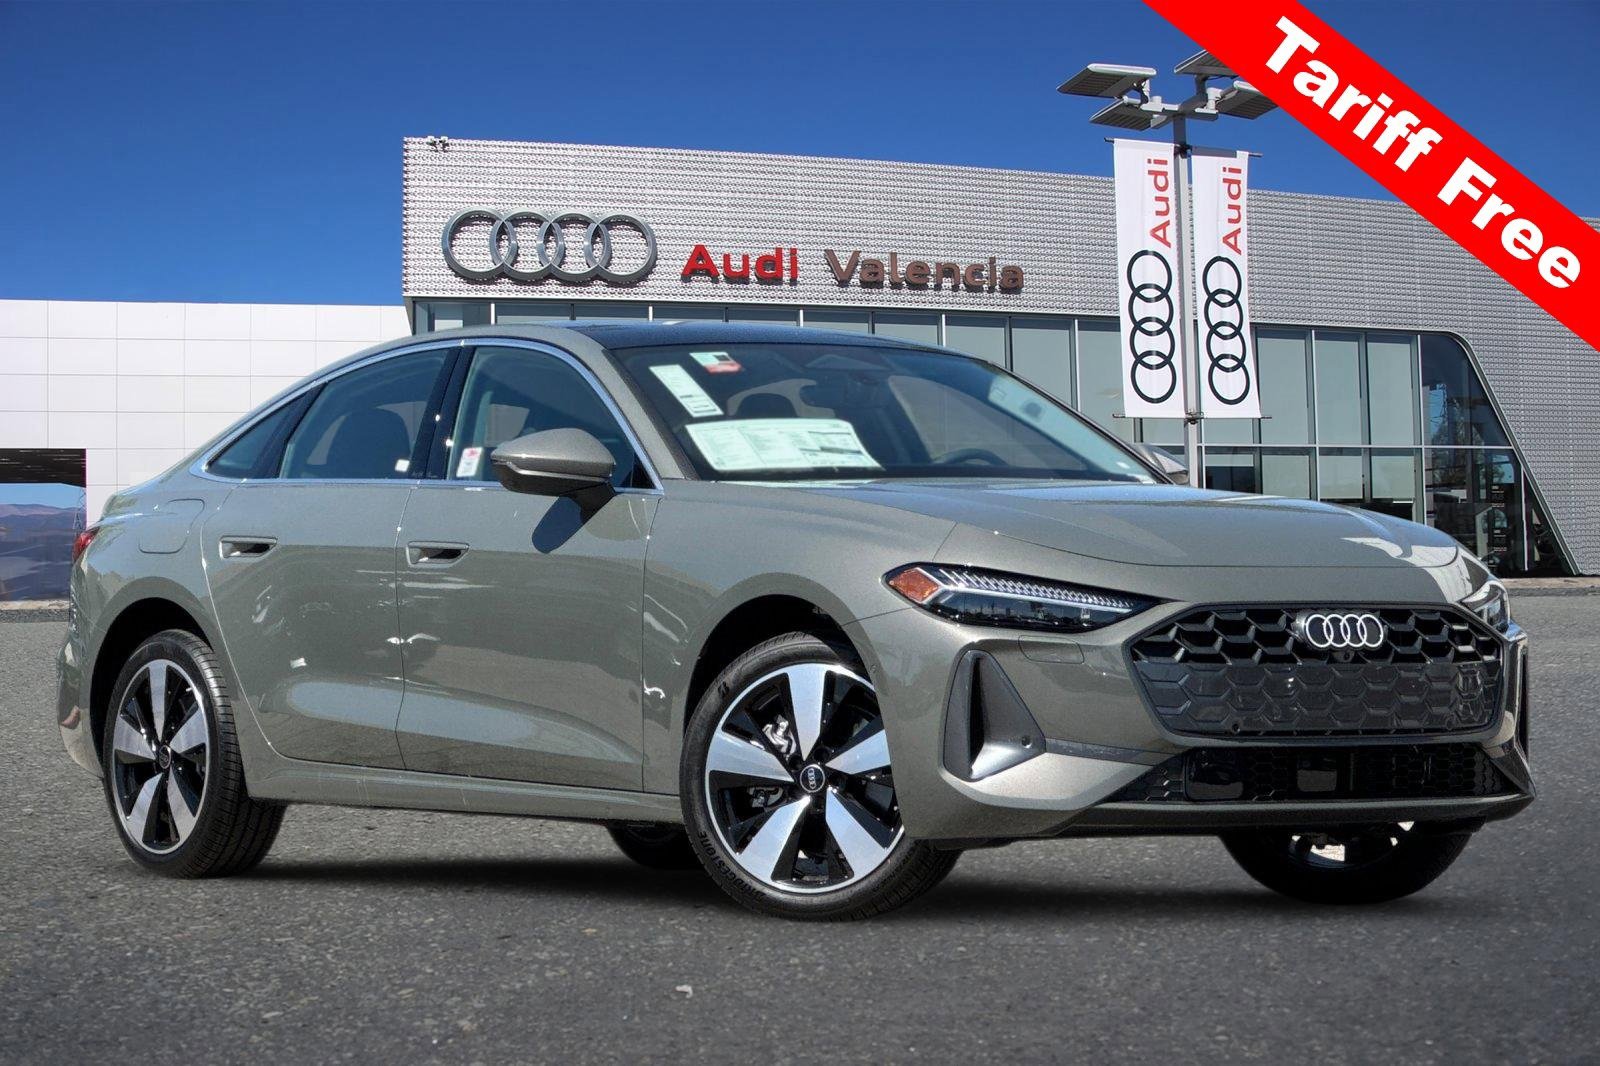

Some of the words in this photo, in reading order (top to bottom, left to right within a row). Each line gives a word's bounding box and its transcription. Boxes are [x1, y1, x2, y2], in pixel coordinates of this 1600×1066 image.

[1147, 158, 1171, 248] Audi
[1222, 166, 1242, 256] Audi
[680, 244, 798, 281] Audi
[824, 249, 1024, 293] Valencia
